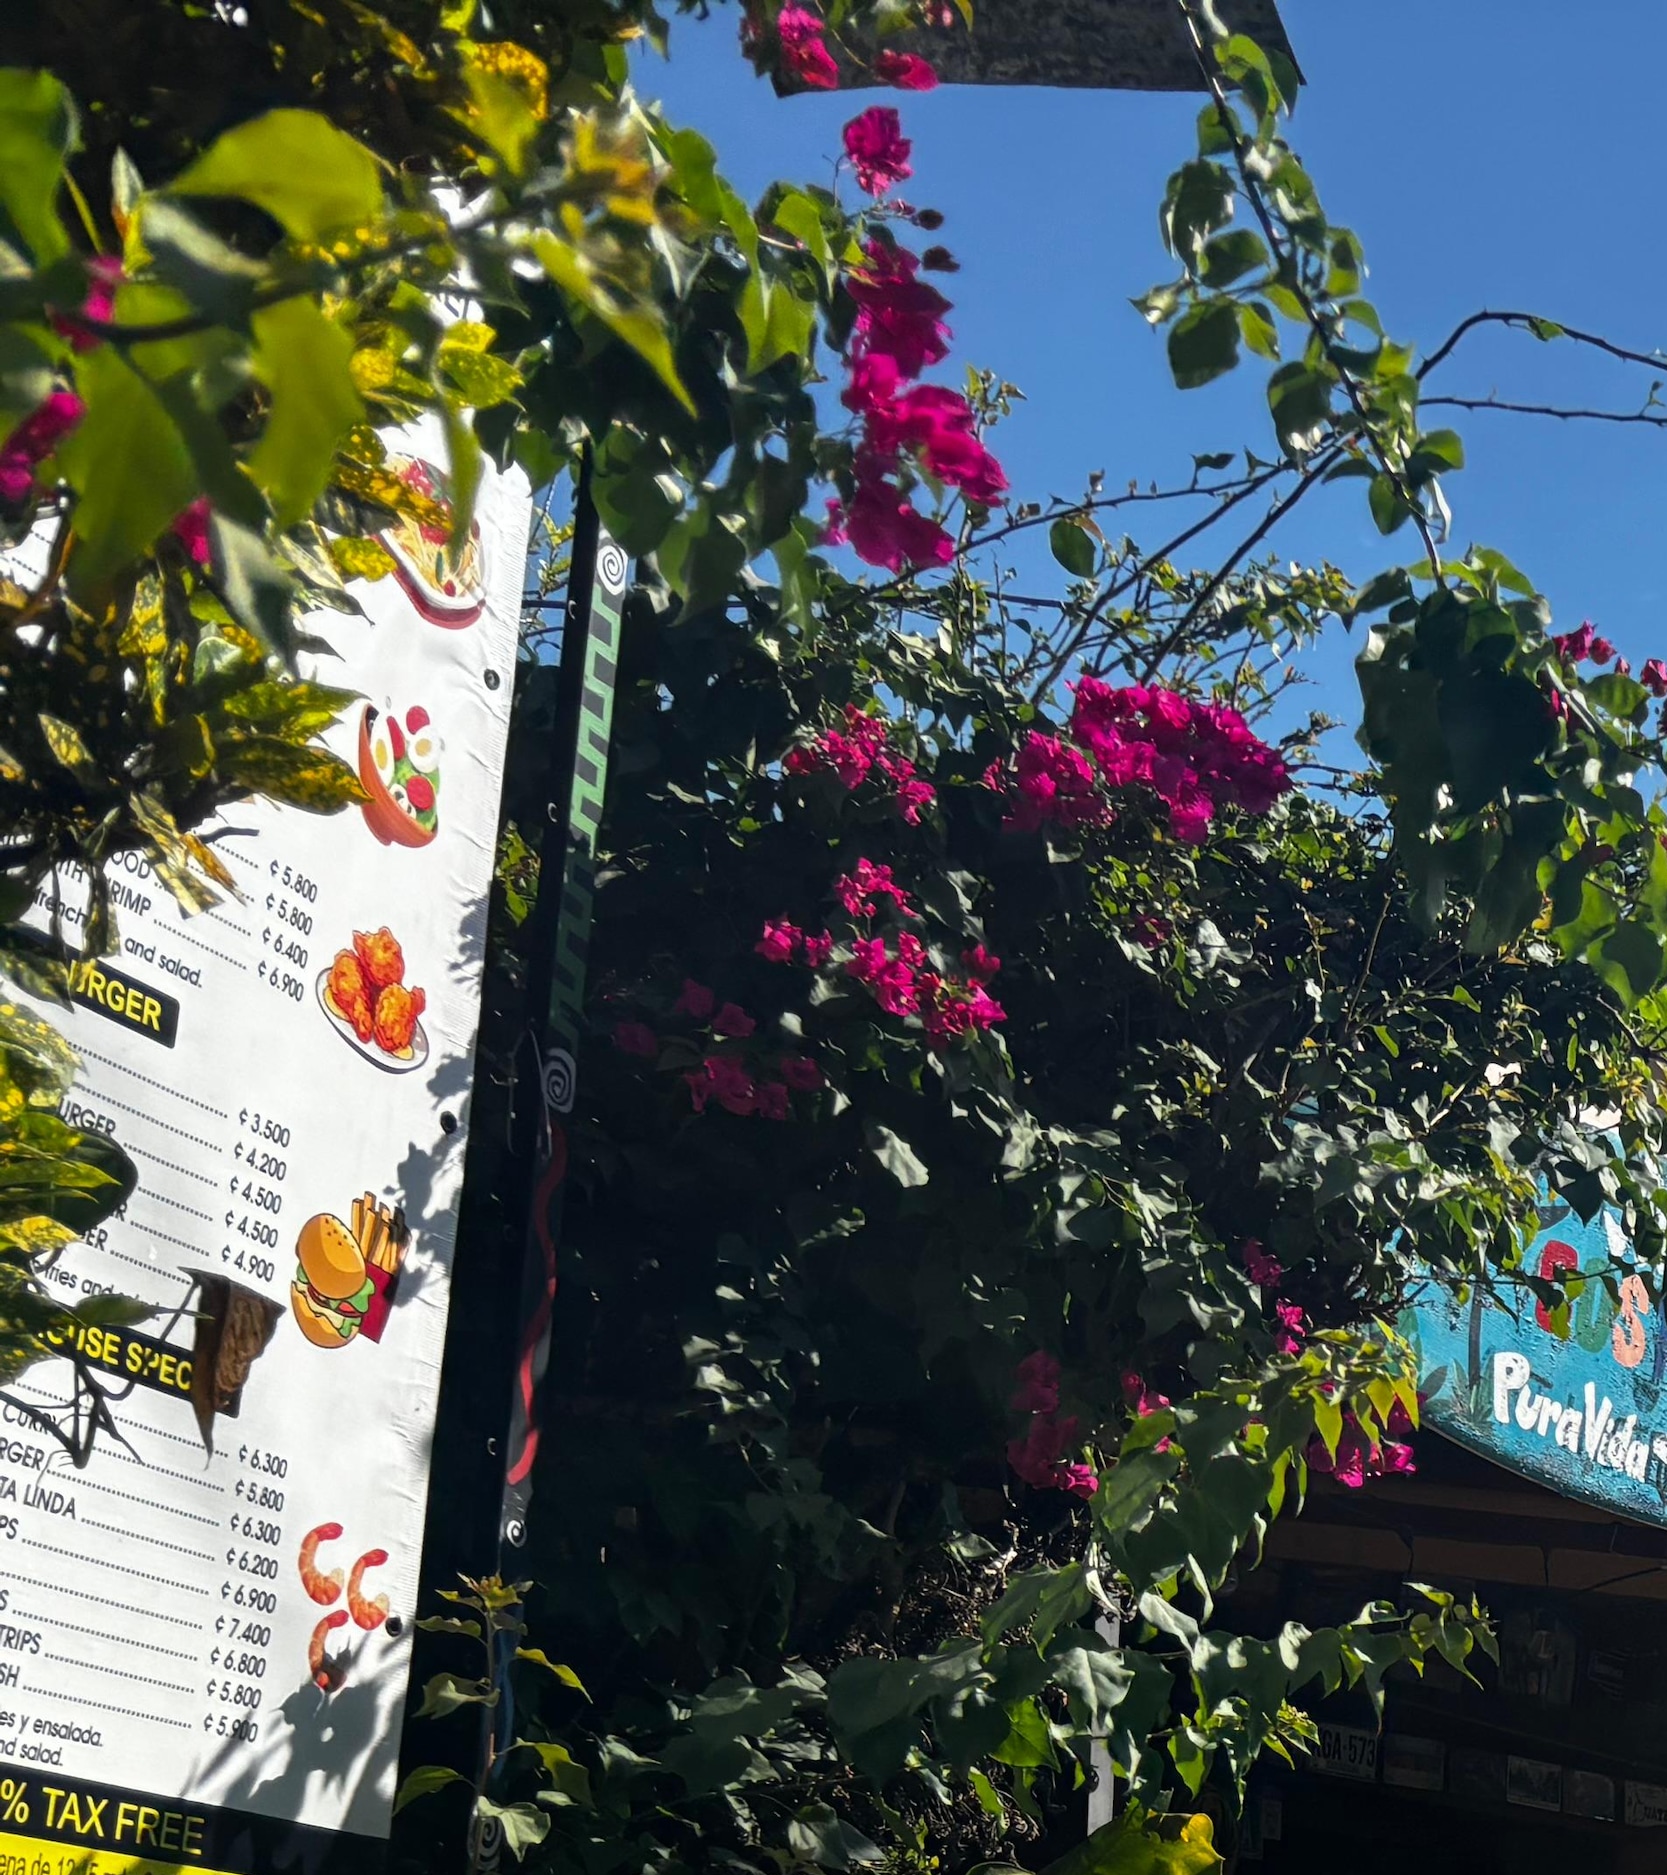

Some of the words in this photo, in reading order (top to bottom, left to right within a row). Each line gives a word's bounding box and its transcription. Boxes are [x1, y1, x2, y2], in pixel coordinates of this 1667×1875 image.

[282, 866, 317, 903] 5.800
[278, 900, 312, 936] 5.800
[124, 937, 156, 963] and
[158, 954, 202, 988] salad.
[274, 934, 308, 969] 6.400
[270, 967, 304, 1002] 6.900
[251, 1113, 291, 1148] 3.500
[246, 1147, 287, 1181] 4.200
[241, 1181, 282, 1215] 4.500
[237, 1216, 279, 1248] 4.500
[234, 1250, 275, 1282] 4.900
[251, 1450, 288, 1479] 6.300
[23, 1484, 76, 1520] LINDA
[243, 1517, 281, 1546] 6.300
[239, 1551, 278, 1579] 6.200
[234, 1585, 277, 1614] 6.900
[0, 1624, 42, 1655] TRIPS
[228, 1618, 271, 1647] 7.400
[224, 1651, 266, 1678] 6.800
[219, 1681, 262, 1709] 5.800
[18, 1715, 30, 1734] y
[33, 1717, 103, 1747] ensalada.
[216, 1716, 258, 1743] 5.900
[20, 1743, 63, 1766] salad.
[42, 1786, 109, 1838] TAX
[115, 1802, 205, 1855] FREE
